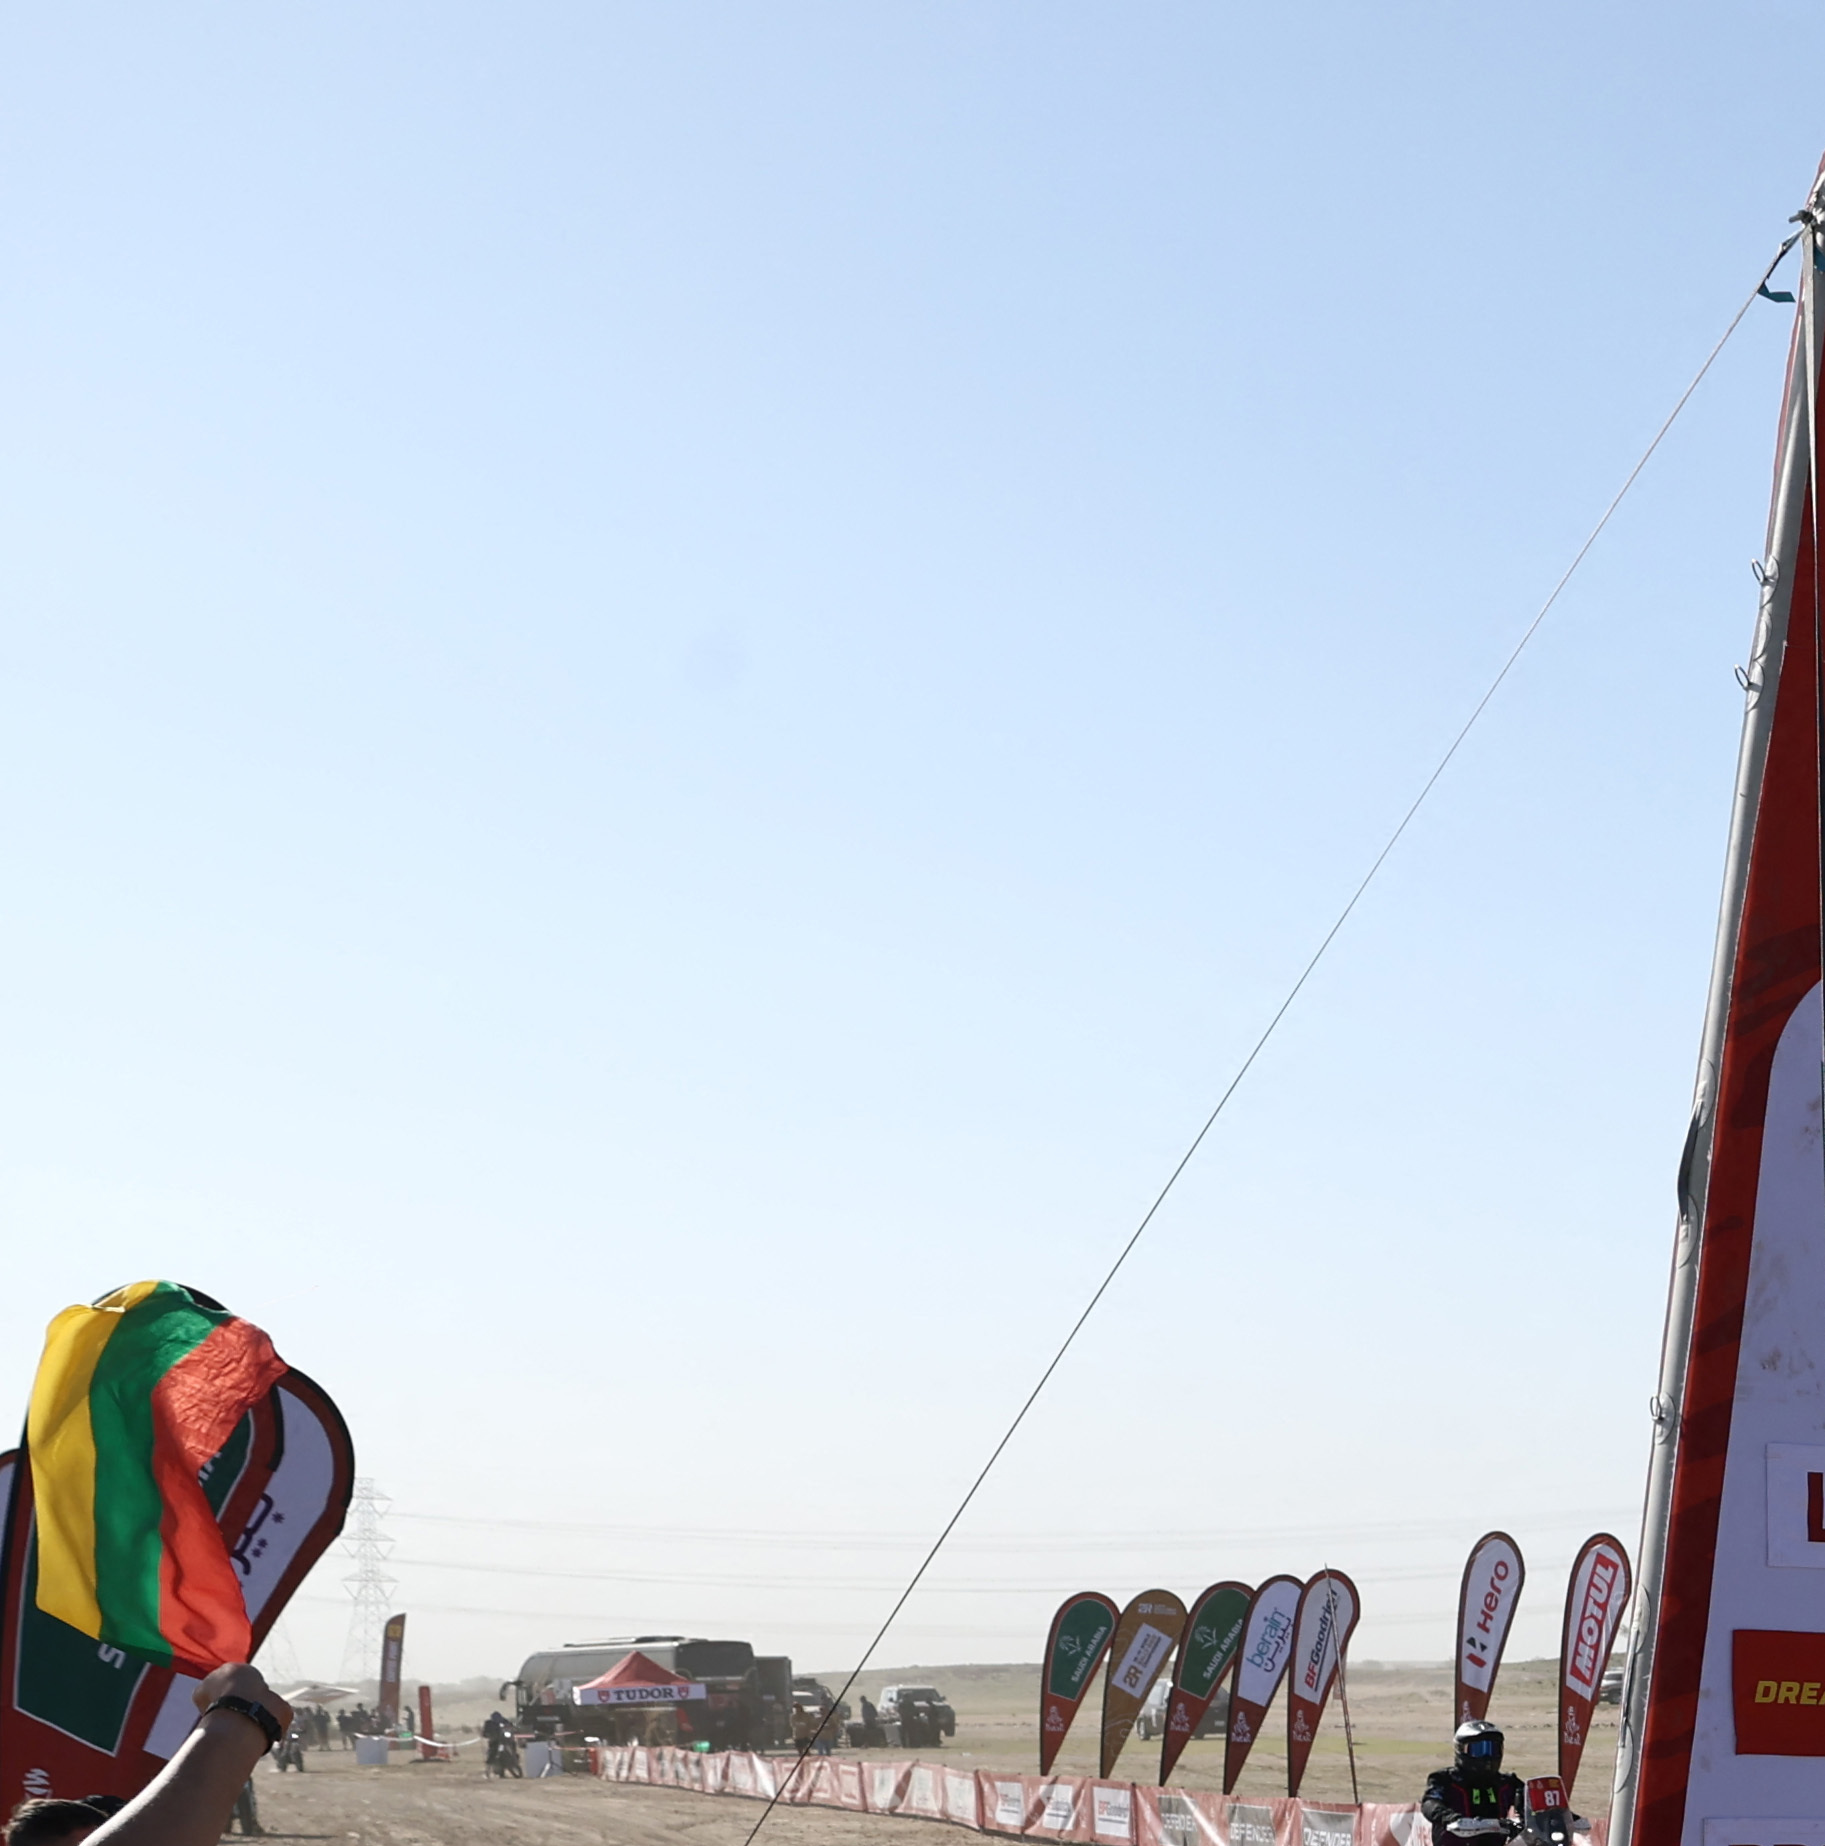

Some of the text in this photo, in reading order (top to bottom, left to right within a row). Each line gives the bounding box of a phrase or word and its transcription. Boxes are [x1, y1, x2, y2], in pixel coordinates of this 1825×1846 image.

[1477, 1560, 1509, 1635] Hero
[1573, 1557, 1618, 1685] MOTUL
[1246, 1608, 1285, 1669] berain
[614, 1686, 675, 1701] TUDOR
[1543, 1790, 1561, 1807] 87
